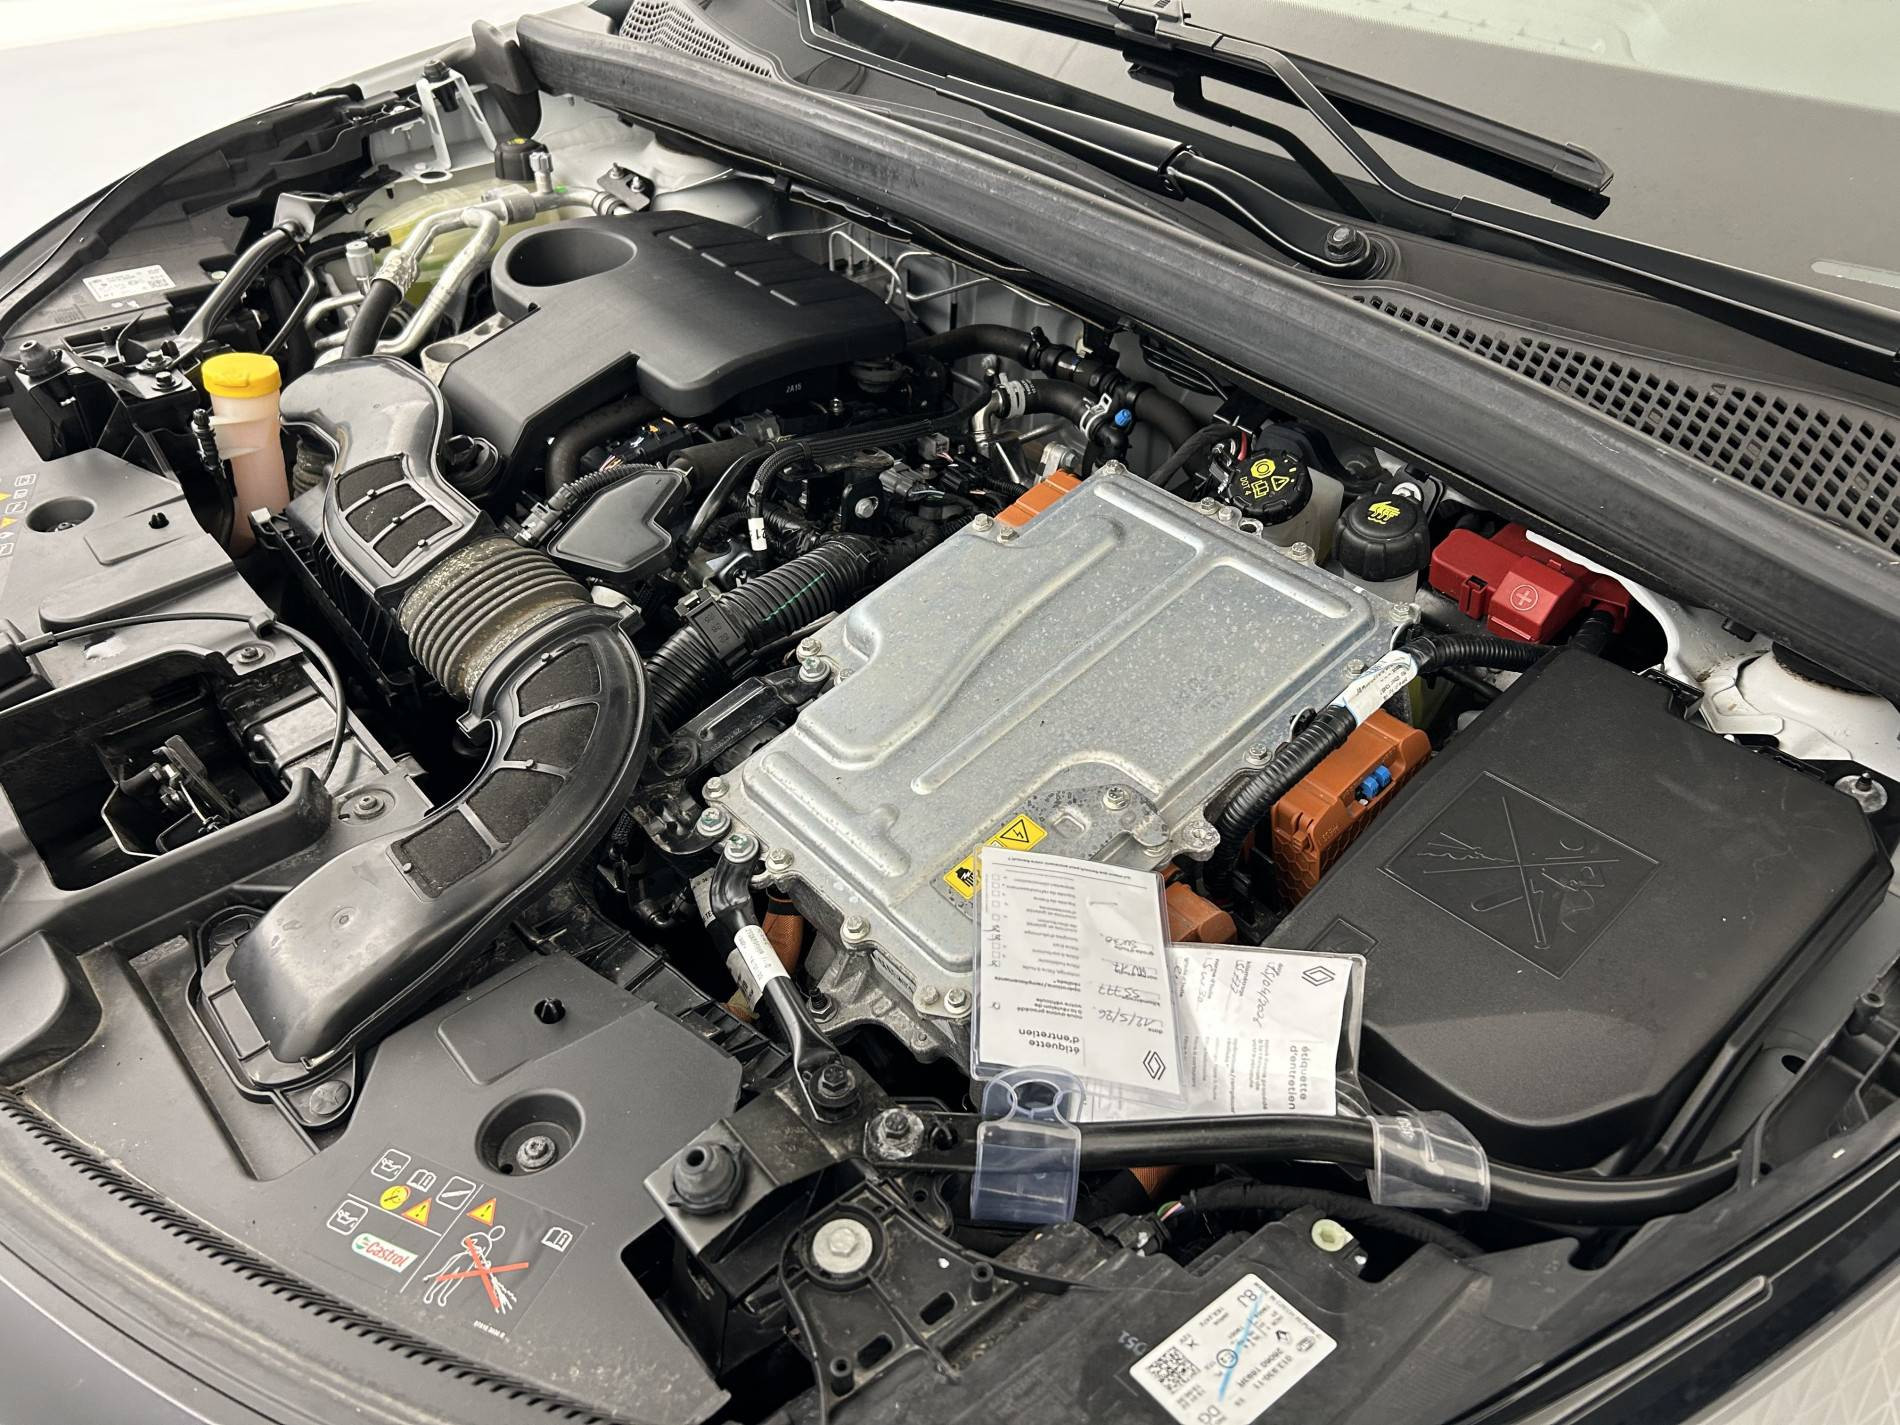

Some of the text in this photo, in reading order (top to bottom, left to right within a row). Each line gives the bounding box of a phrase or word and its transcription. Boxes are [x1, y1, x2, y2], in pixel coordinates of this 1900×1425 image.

[1240, 476, 1250, 489] DOT
[1017, 1028, 1079, 1044] d'entretien
[1027, 1038, 1080, 1055] étiquette
[1287, 1045, 1297, 1109] d'entretien
[366, 1240, 410, 1268] Castrol
